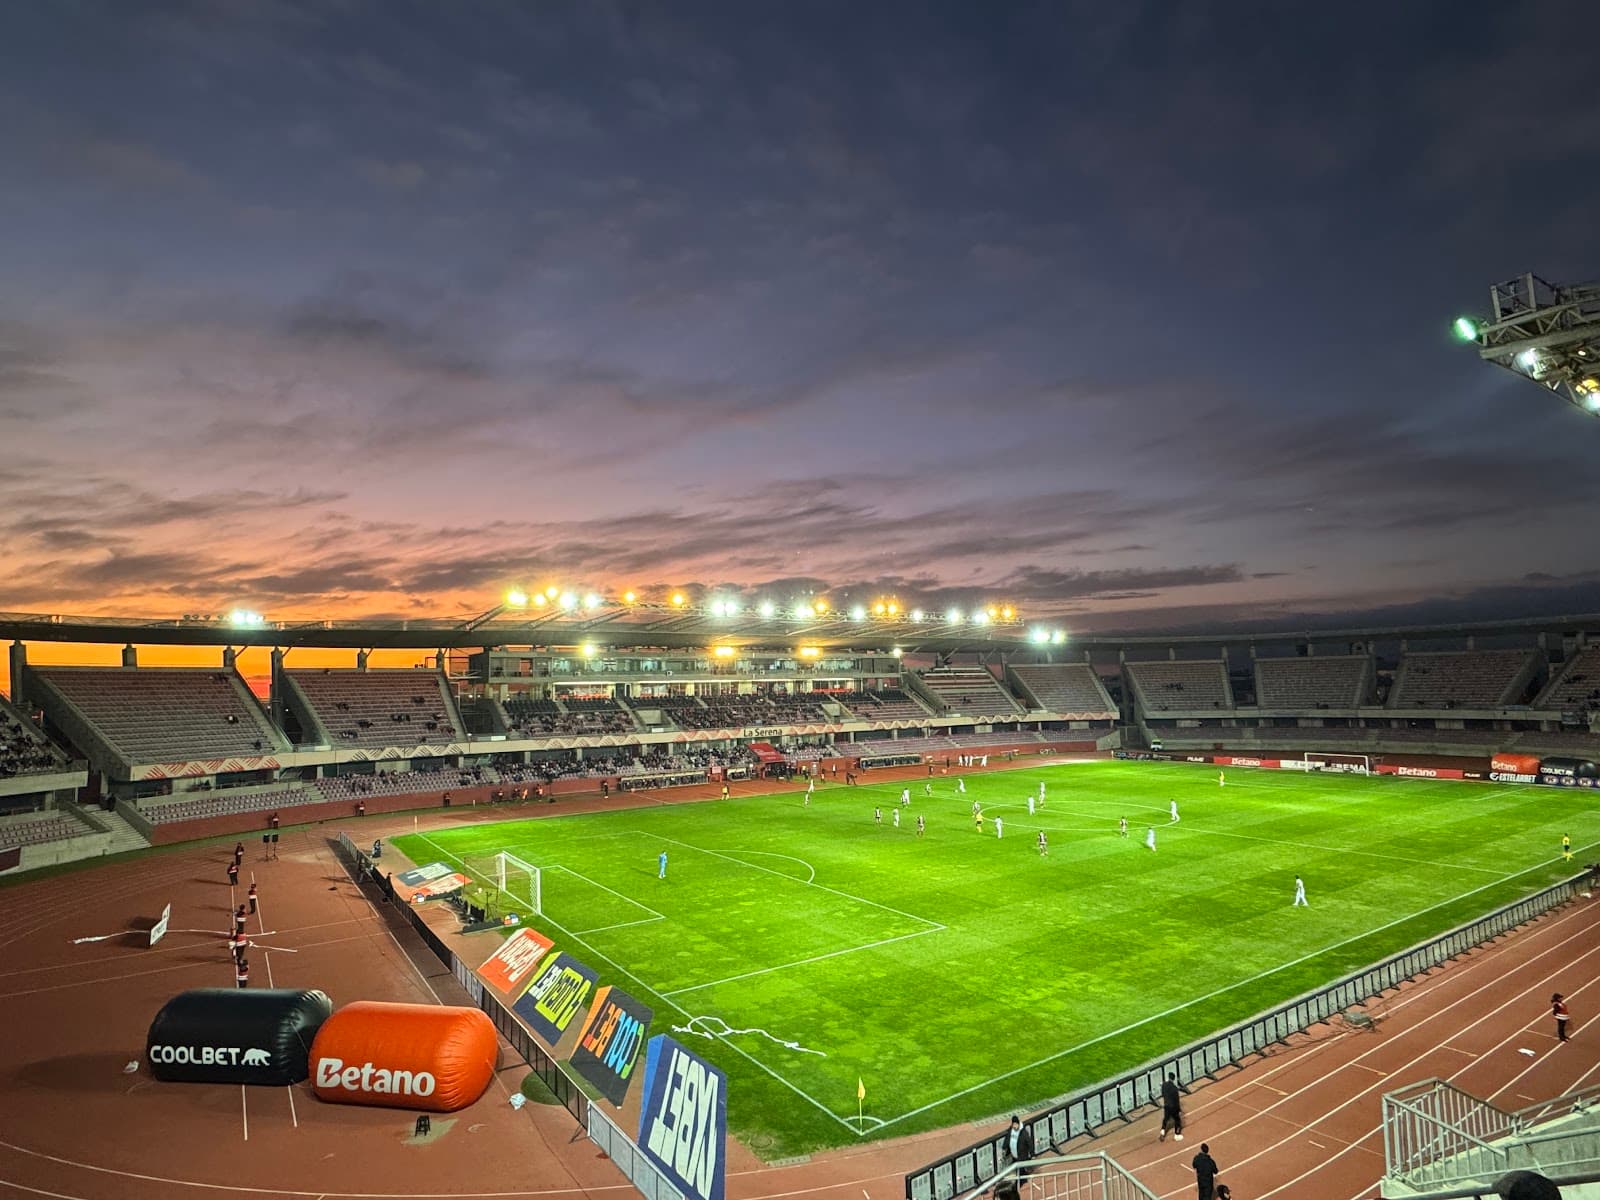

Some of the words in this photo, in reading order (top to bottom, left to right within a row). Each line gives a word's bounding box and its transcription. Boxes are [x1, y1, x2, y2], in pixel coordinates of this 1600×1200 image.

[743, 729, 753, 737] La
[755, 728, 783, 737] Serena
[1231, 757, 1261, 767] Betano
[1491, 760, 1517, 772] Betano
[1398, 766, 1437, 777] Betano
[582, 1001, 645, 1080] COOLBET
[150, 1045, 241, 1066] COOLBET
[316, 1057, 435, 1097] Betano
[648, 1047, 719, 1200] 1XBET
